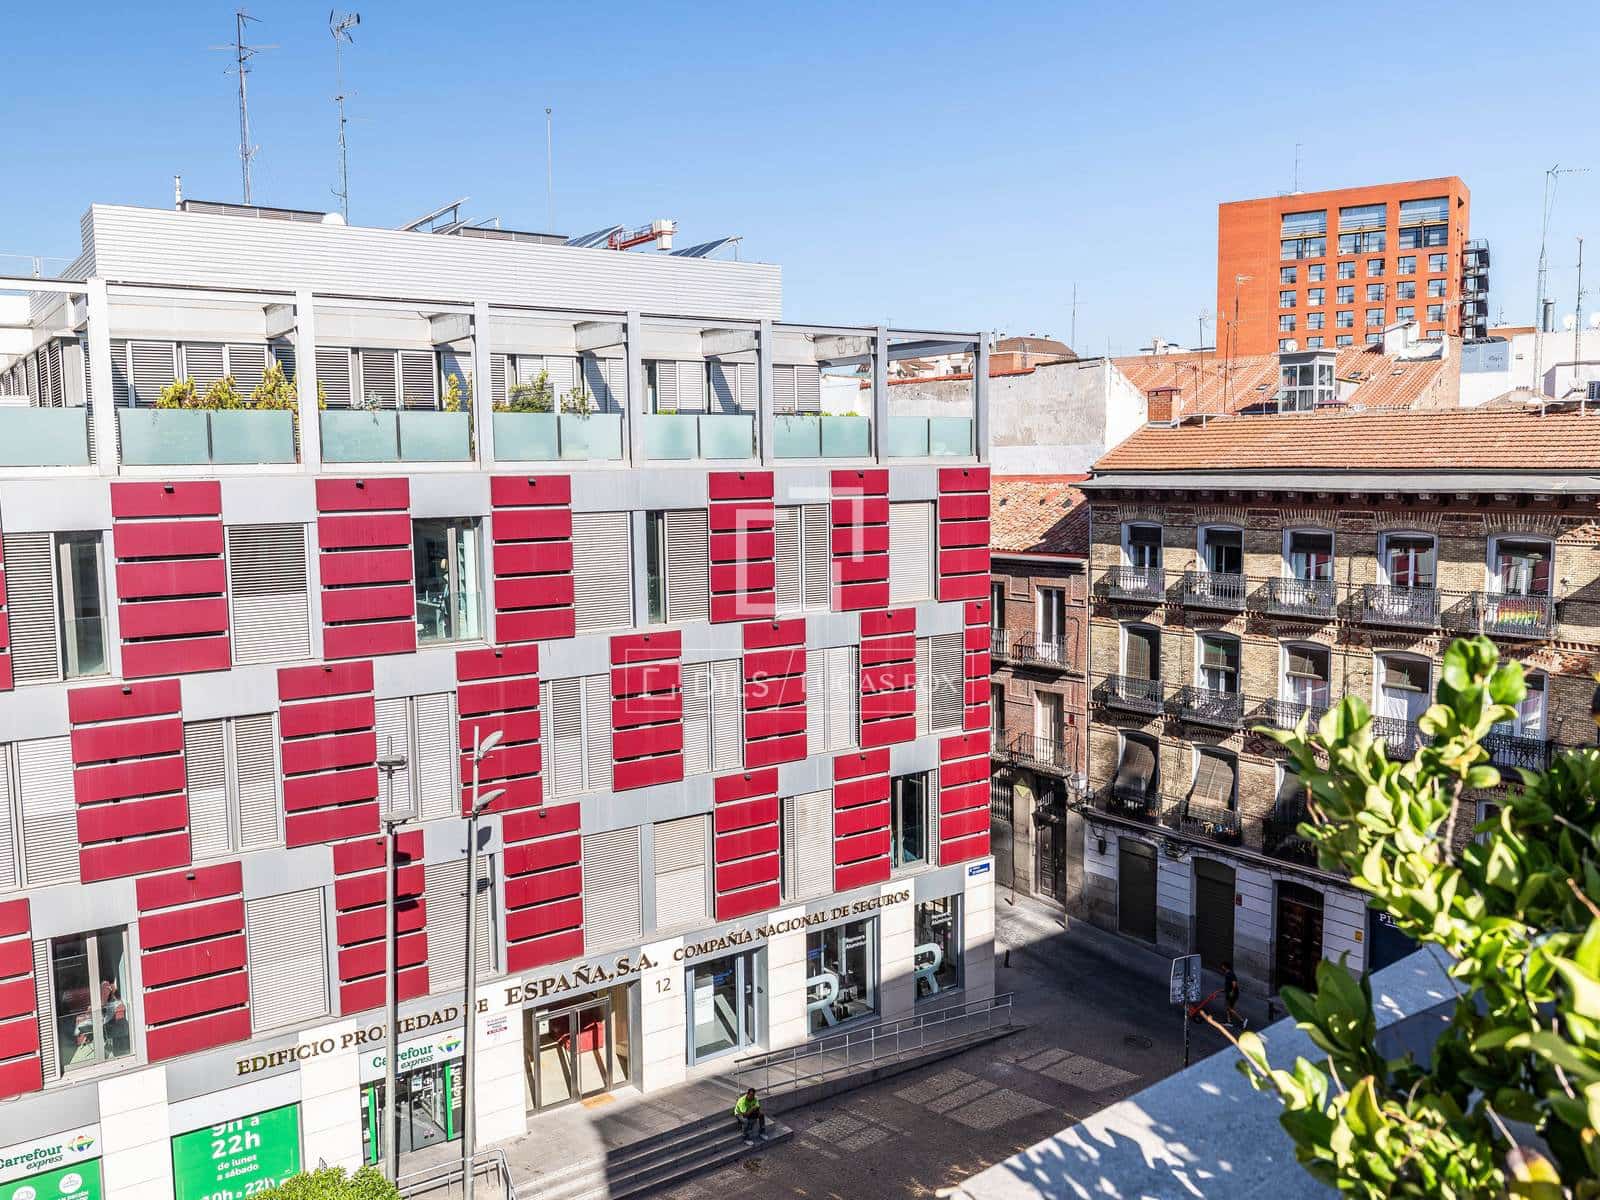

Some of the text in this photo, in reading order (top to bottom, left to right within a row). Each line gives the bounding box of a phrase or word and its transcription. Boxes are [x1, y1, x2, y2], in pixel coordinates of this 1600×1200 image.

[236, 1038, 335, 1076] EDIFICIO
[341, 1007, 458, 1049] PROIEDAD
[673, 928, 752, 961] COMPAÑÍA
[755, 911, 829, 941] NACIONAL
[831, 906, 849, 921] DE
[852, 890, 910, 914] SEGUROS
[655, 978, 671, 994] 12
[372, 1045, 433, 1067] Carefour
[401, 1055, 433, 1069] express
[211, 1131, 261, 1159] 22h
[26, 1154, 63, 1170] express
[217, 1154, 257, 1171] de lunes
[225, 1164, 259, 1179] sábado
